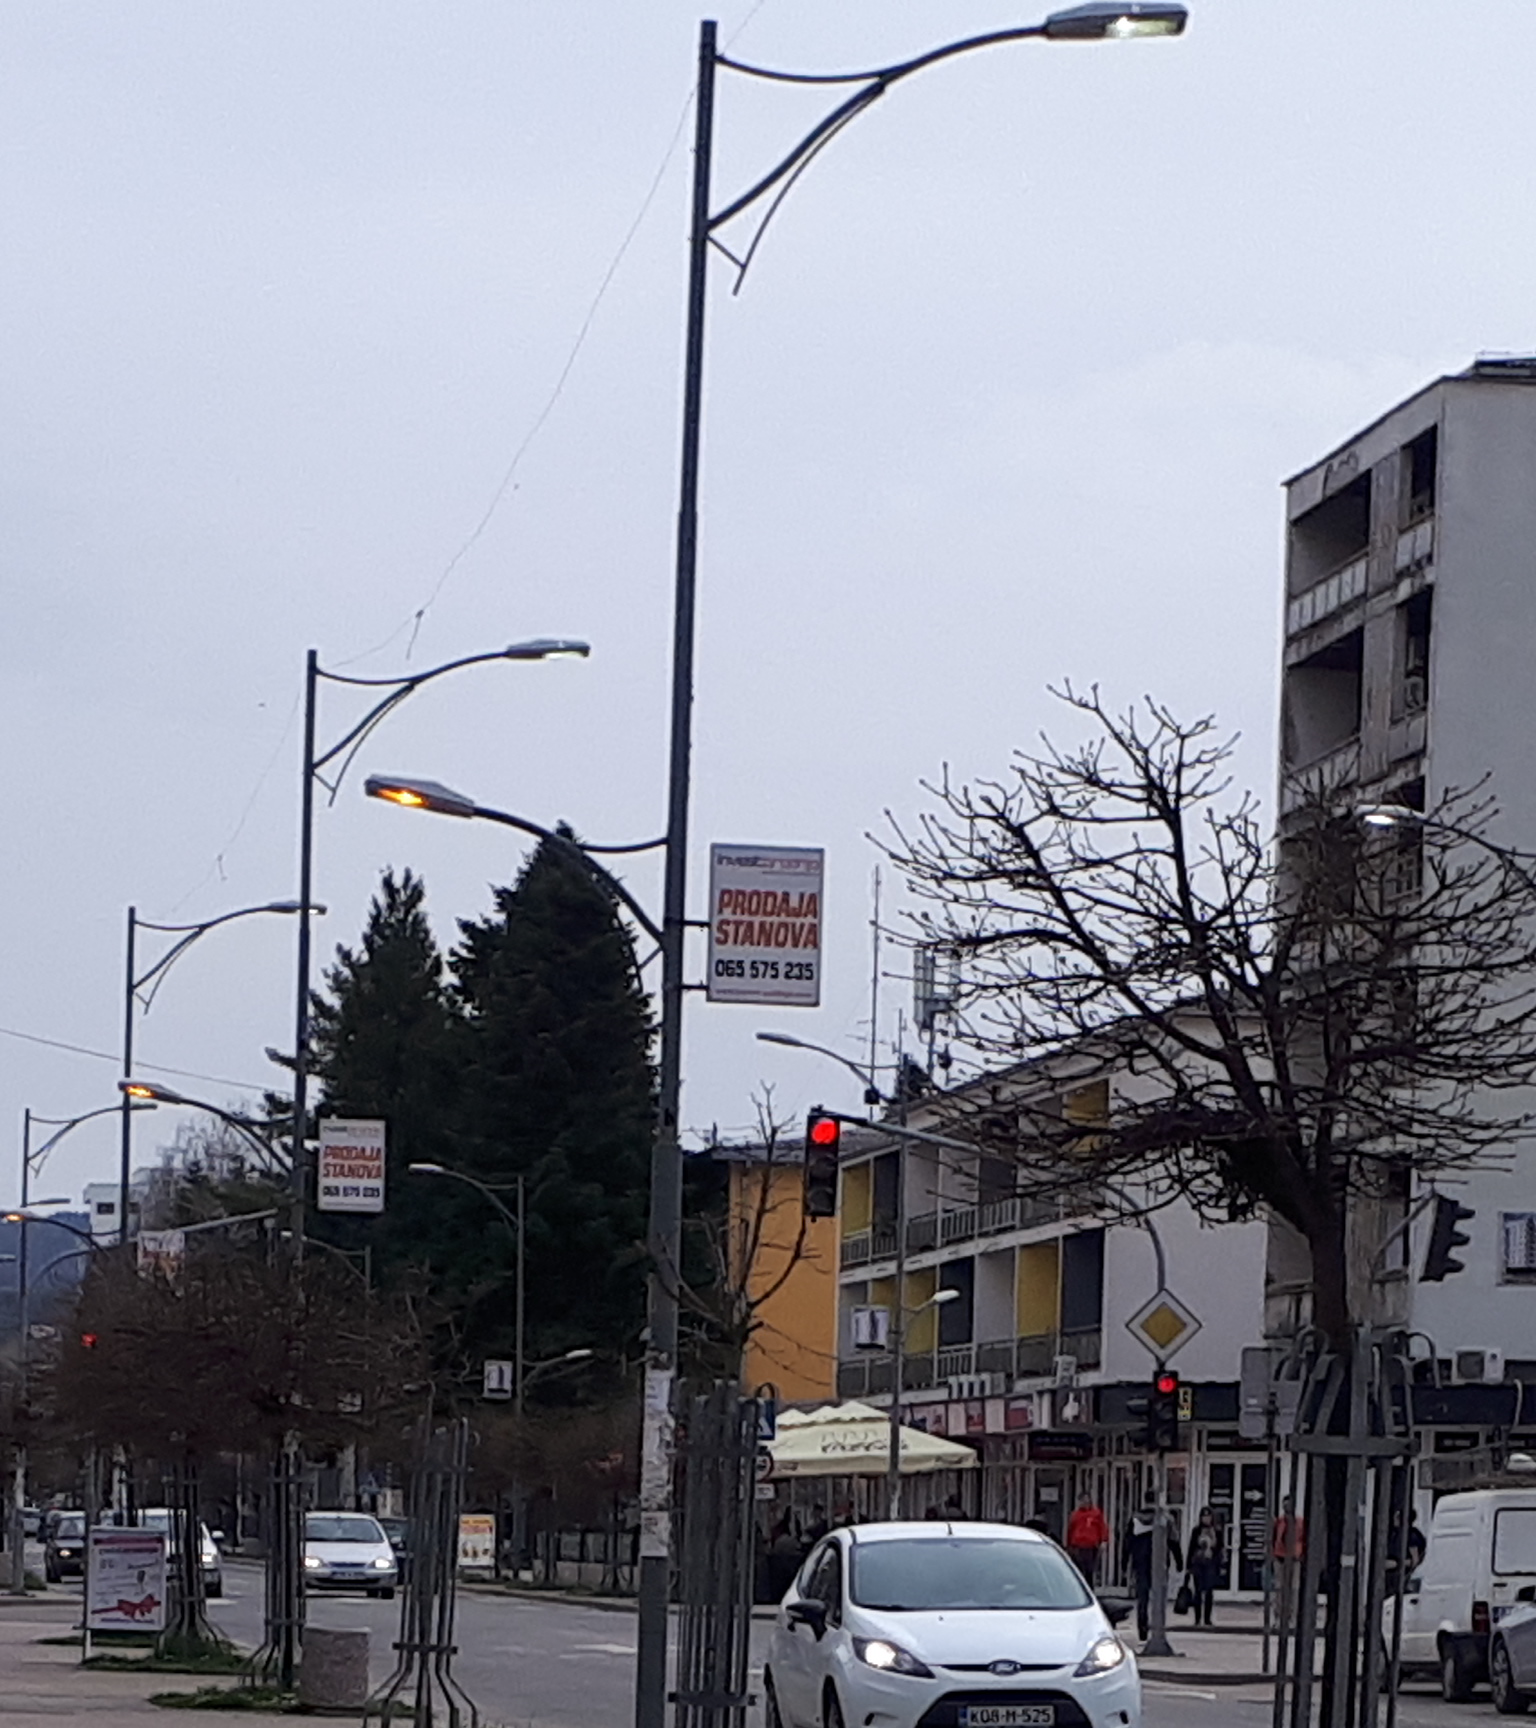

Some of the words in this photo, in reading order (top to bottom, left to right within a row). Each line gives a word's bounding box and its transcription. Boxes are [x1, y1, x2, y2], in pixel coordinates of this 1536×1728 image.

[718, 888, 819, 919] PRODAJA
[715, 919, 819, 949] STANOVA
[715, 959, 745, 977] 065
[750, 960, 779, 979] 575
[784, 962, 814, 980] 235
